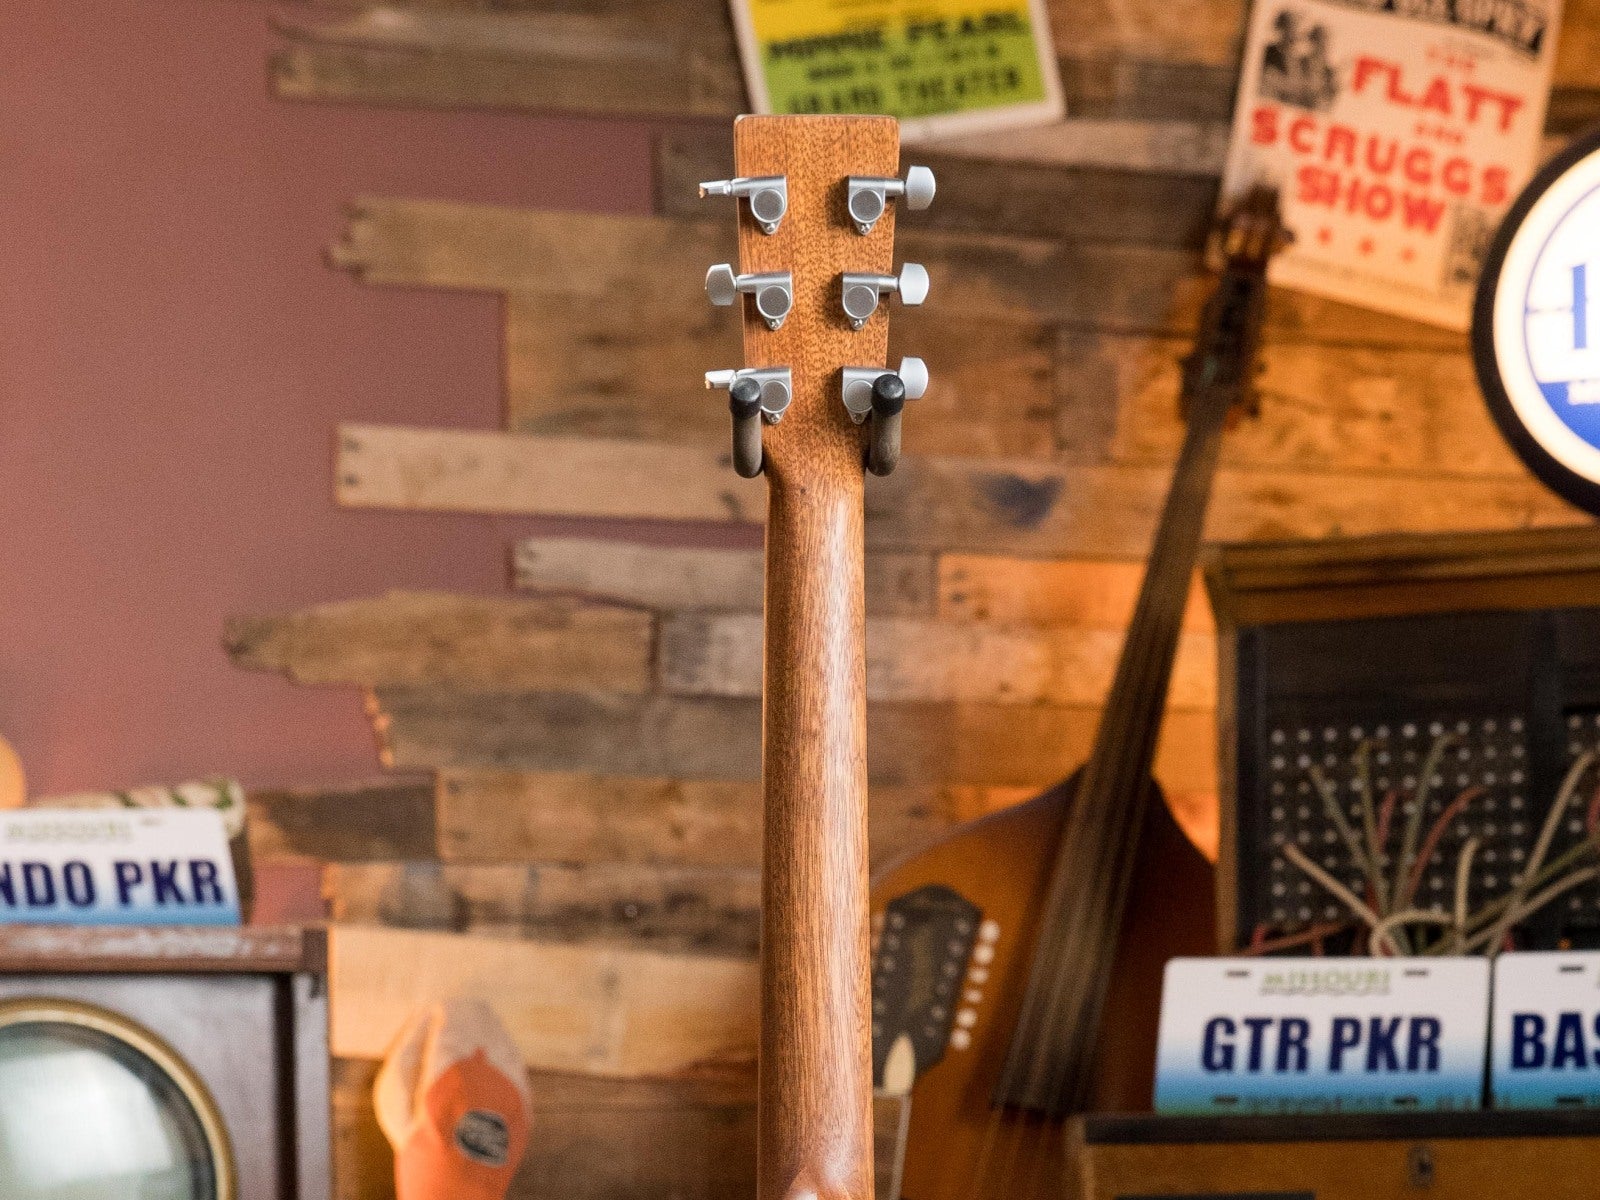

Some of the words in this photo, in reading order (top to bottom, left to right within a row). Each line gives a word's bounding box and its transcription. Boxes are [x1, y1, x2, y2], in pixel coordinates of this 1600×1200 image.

[905, 12, 1026, 44] PEARL
[1353, 55, 1525, 133] FLATT
[1251, 104, 1508, 206] SCRUGGS
[1298, 165, 1446, 235] SHOW
[113, 860, 225, 906] PKR
[1202, 1016, 1311, 1074] GTR
[1328, 1014, 1441, 1073] PKR
[1512, 1012, 1600, 1069] BA
